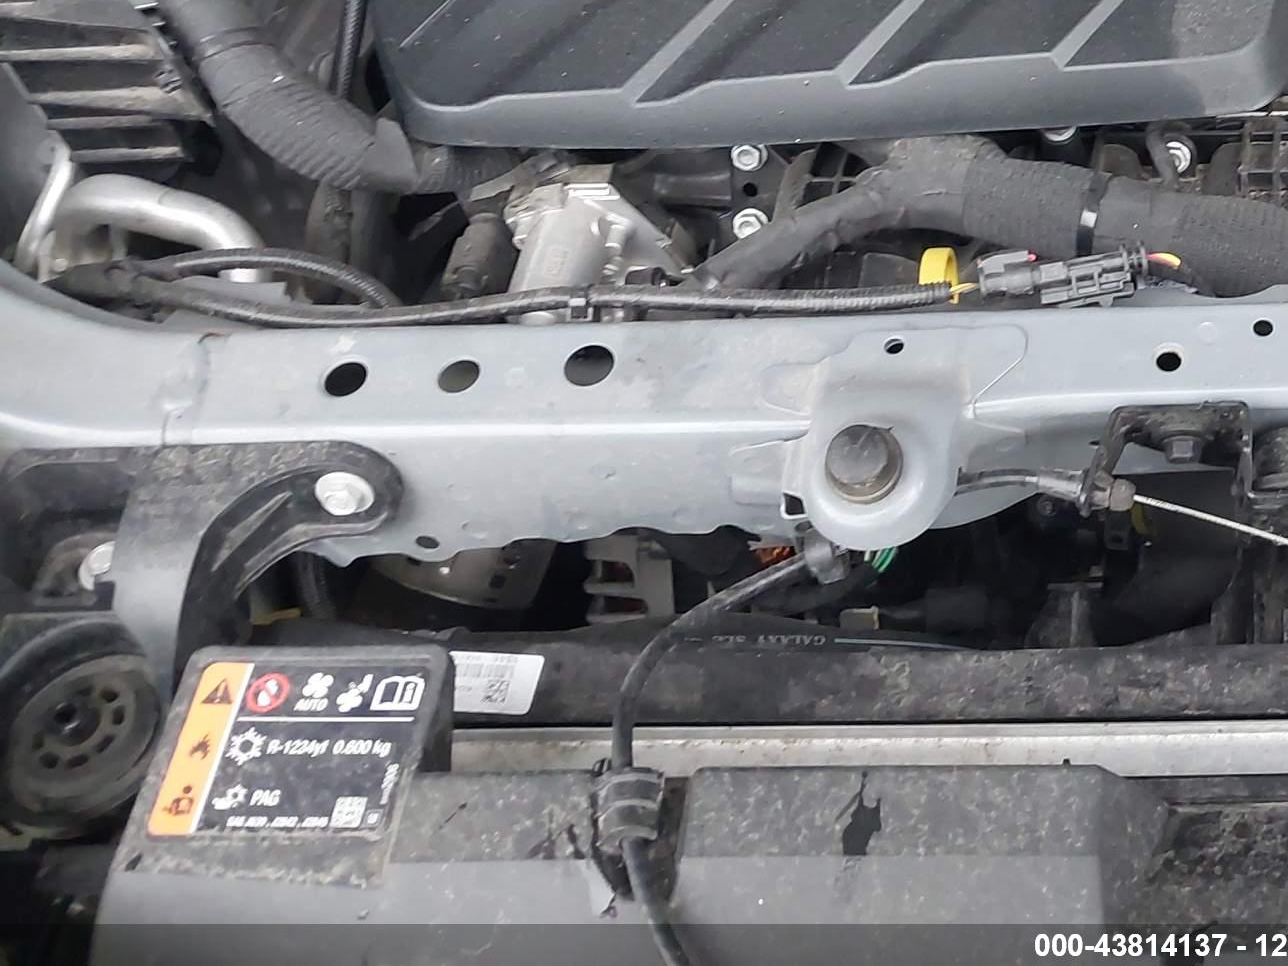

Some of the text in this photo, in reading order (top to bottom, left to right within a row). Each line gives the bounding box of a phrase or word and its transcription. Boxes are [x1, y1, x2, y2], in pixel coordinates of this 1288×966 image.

[293, 698, 329, 712] AUTO
[371, 738, 392, 758] kg
[249, 789, 282, 807] PAG
